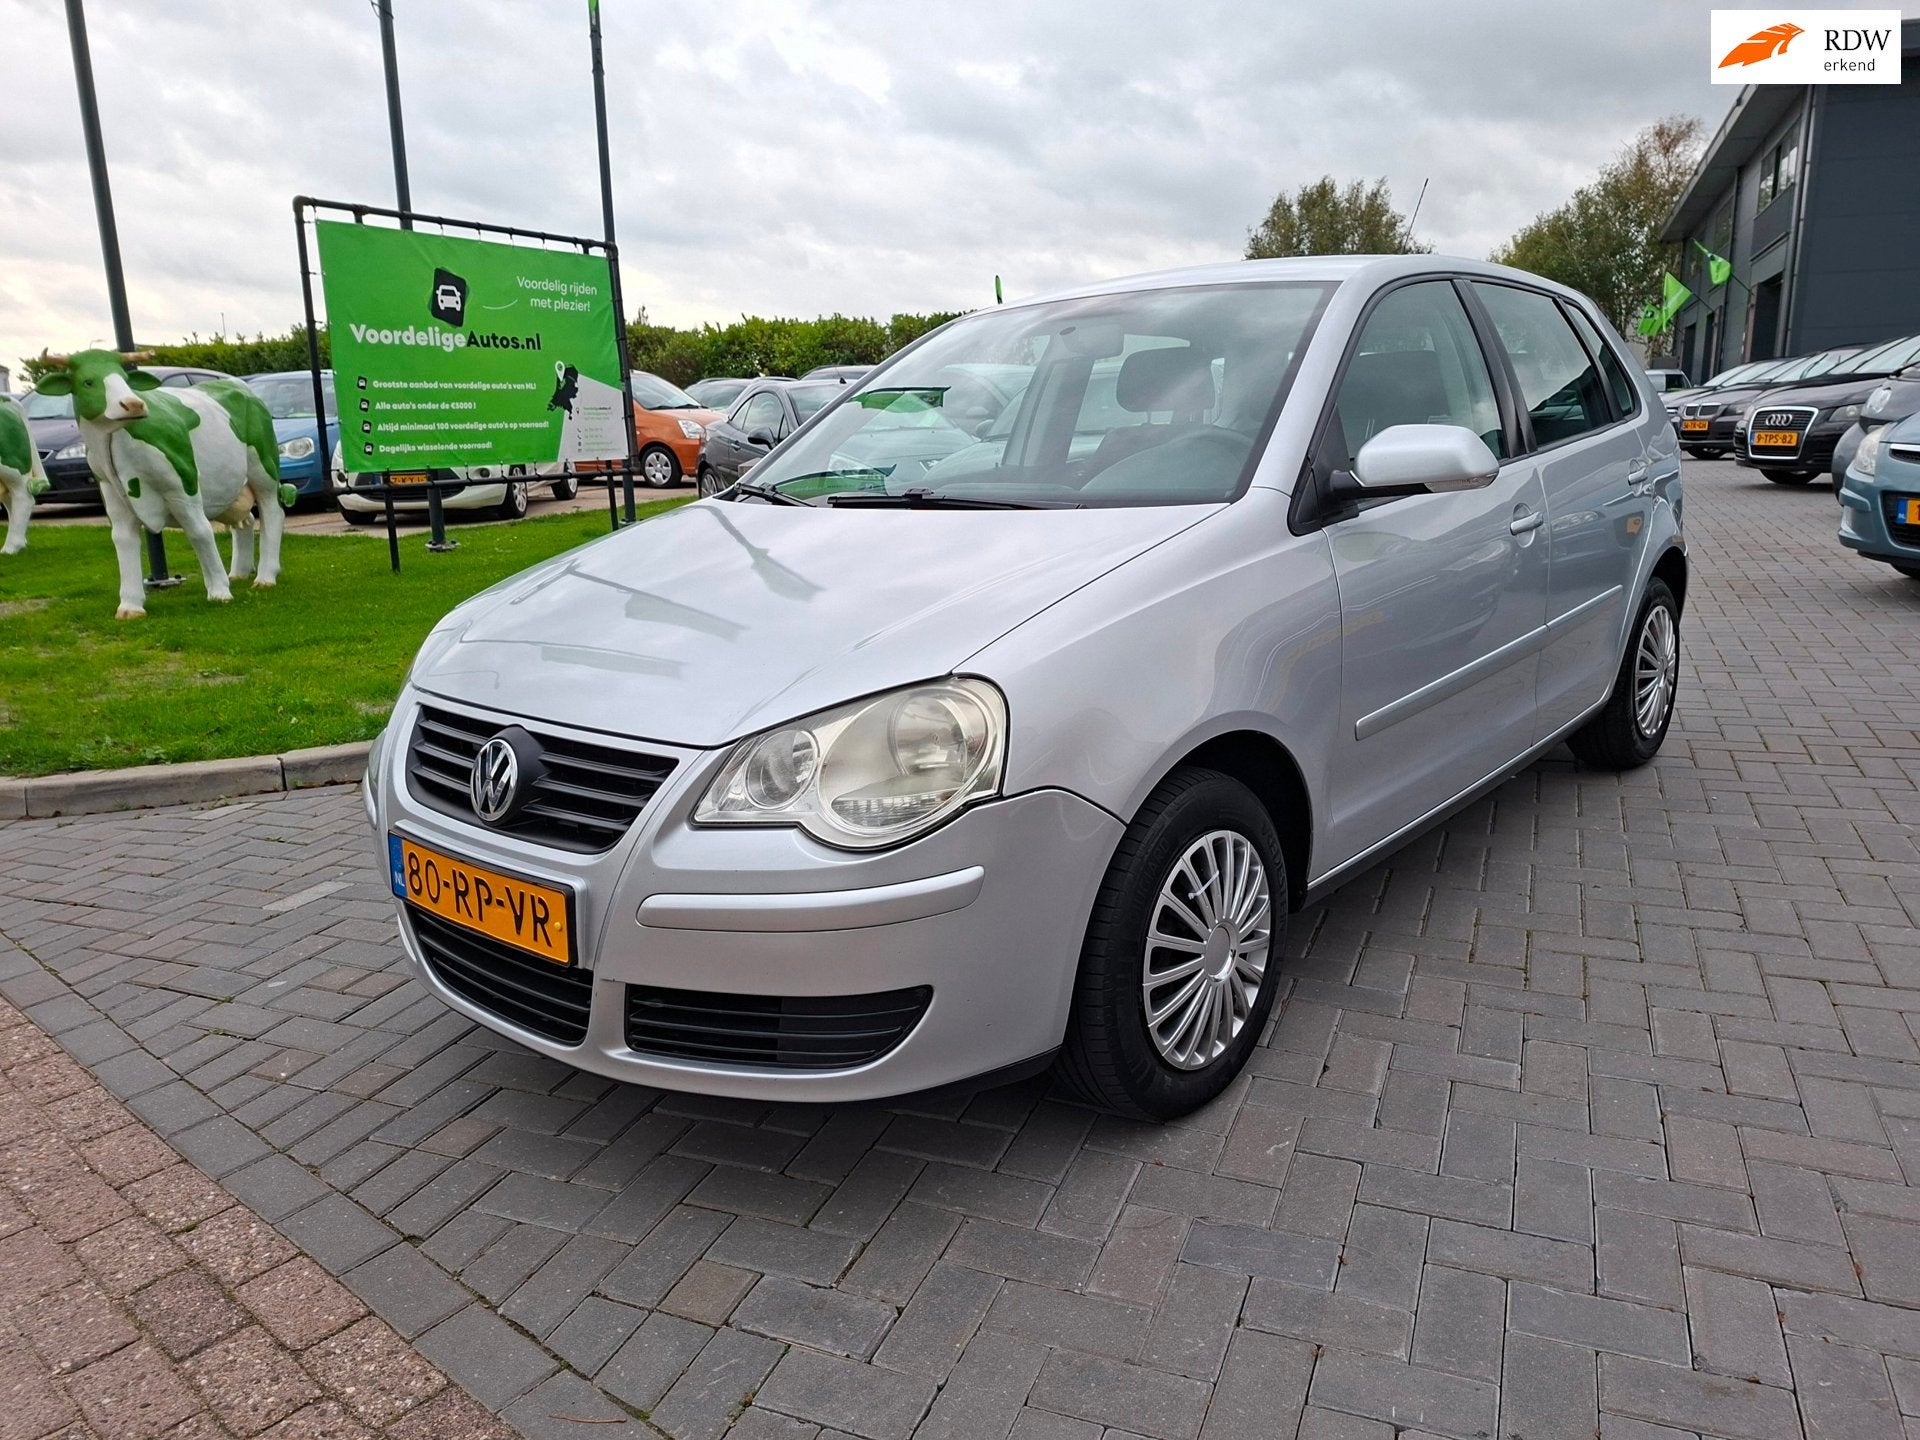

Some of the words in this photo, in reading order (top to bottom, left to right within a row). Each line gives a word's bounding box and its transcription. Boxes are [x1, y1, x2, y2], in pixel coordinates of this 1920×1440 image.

[516, 275, 568, 295] Voordelig
[569, 282, 598, 297] rijden
[530, 298, 552, 309] met
[554, 298, 591, 312] plezier!
[349, 323, 542, 353] VoordeligeAutos.nl
[372, 380, 408, 389] Grootste
[409, 380, 438, 389] aanbod
[453, 381, 491, 391] voordelige
[491, 381, 512, 390] auto's
[512, 382, 525, 390] van
[525, 382, 537, 390] NL!
[375, 401, 391, 410] Alle
[392, 401, 417, 410] auto's
[417, 402, 439, 410] onder
[440, 401, 450, 410] de
[377, 422, 399, 433] Altijd
[400, 422, 436, 431] minimaal
[436, 422, 449, 430] 100
[450, 421, 487, 431] voordelige
[487, 421, 508, 429] auto's
[509, 422, 518, 430] op
[518, 420, 549, 428] voorraad!
[1756, 433, 1793, 444] 9-TPS-82
[379, 443, 416, 454] Dagelijks
[416, 442, 458, 451] wisselende
[459, 441, 493, 450] voorraad!
[394, 870, 405, 888] NL
[407, 851, 553, 948] 80-RP-VR
